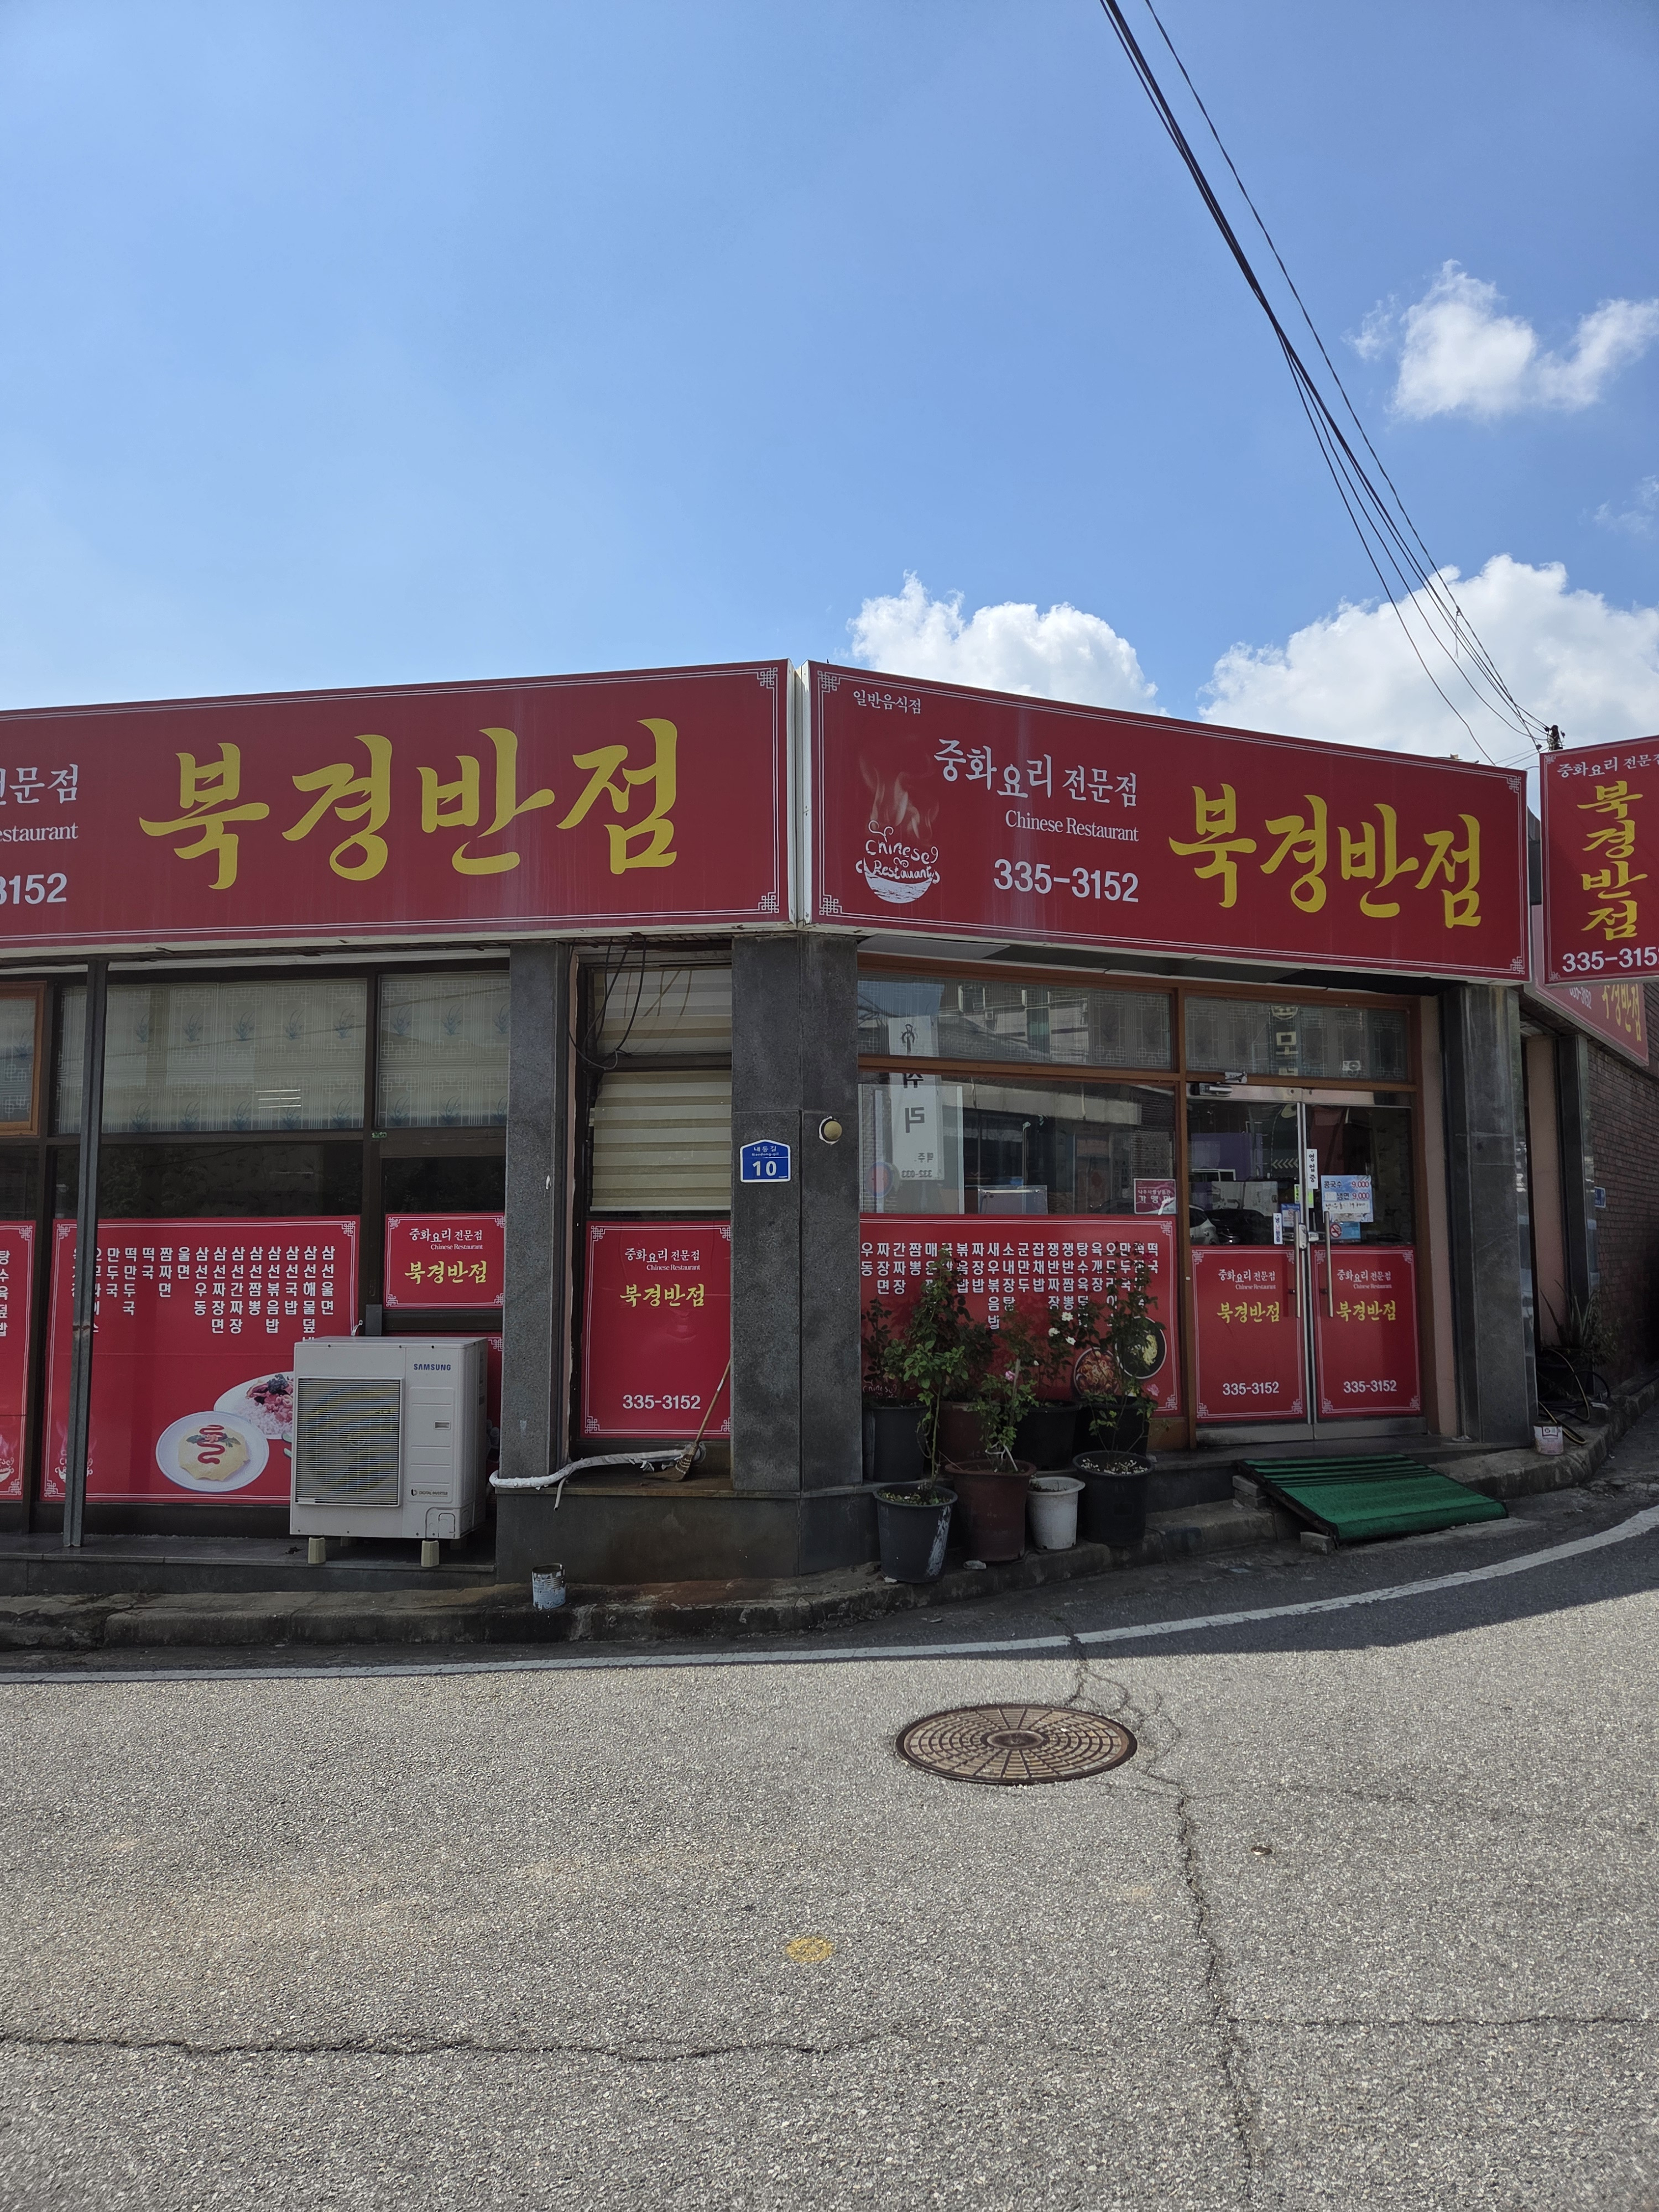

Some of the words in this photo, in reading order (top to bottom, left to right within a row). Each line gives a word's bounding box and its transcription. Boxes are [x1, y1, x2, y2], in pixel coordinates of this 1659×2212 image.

[853, 689, 922, 715] 일반음식점
[0, 764, 79, 805] 문점
[933, 738, 1052, 799] 중화요리
[1062, 765, 1137, 808] 전문점
[1557, 756, 1618, 779] 중화요리
[139, 718, 677, 890] 북경반점
[1005, 809, 1063, 834] Chinese
[1066, 817, 1139, 842] Restaurant
[1168, 782, 1481, 929] 북경반점
[1577, 780, 1648, 941] 북경반점
[994, 858, 1139, 903] 335-3152
[1562, 946, 1659, 973] 335-315
[752, 1160, 777, 1177] 10
[1351, 1180, 1369, 1188] 9,000
[1352, 1192, 1370, 1200] 9,000
[409, 1228, 451, 1243] 중화요리
[454, 1229, 483, 1241] 전문점
[624, 1248, 668, 1263] 중화요리
[671, 1249, 700, 1261] 전문점
[860, 1241, 874, 1276] 우동
[909, 1242, 922, 1276] 짬뽕
[1147, 1243, 1159, 1274] 떡국
[106, 1248, 121, 1298] 만두국
[122, 1247, 137, 1316] 떡만두국
[142, 1247, 154, 1280] 떡국
[158, 1247, 174, 1297] 짬짜면
[177, 1246, 191, 1280] 울면
[194, 1246, 210, 1316] 삼선우동
[248, 1246, 264, 1316] 삼선짬뽕
[284, 1245, 300, 1316] 삼선국밥
[321, 1245, 336, 1315] 삼선울면
[404, 1260, 487, 1285] 북경반점
[877, 1242, 890, 1295] 짜장면
[893, 1242, 906, 1295] 간짜장
[956, 1243, 969, 1293] 볶음밥
[972, 1242, 985, 1293] 짜장밥
[987, 1242, 1000, 1330] 새우볶음밥
[1002, 1242, 1016, 1312] 소내장탕
[1018, 1243, 1030, 1292] 군만두
[1032, 1243, 1045, 1293] 잡채밥
[1047, 1243, 1060, 1310] 쟁반짜장
[1062, 1243, 1074, 1311] 쟁반짬뽕
[1091, 1242, 1103, 1292] 육개장
[1119, 1243, 1131, 1292] 만두국
[1218, 1269, 1251, 1283] 중화요리
[1253, 1270, 1276, 1281] 전문점
[1337, 1269, 1369, 1282] 중화요리
[1370, 1270, 1391, 1281] 전문점
[211, 1246, 227, 1334] 삼선짜장면
[229, 1246, 246, 1334] 삼선간짜장
[265, 1246, 282, 1333] 삼선볶음밥
[619, 1283, 705, 1307] 북경반점
[1217, 1301, 1280, 1324] 북경반점
[1336, 1300, 1396, 1322] 북경반점
[622, 1394, 701, 1410] 335-3152
[1222, 1381, 1280, 1396] 335-3152
[1343, 1379, 1397, 1394] 335-3152
